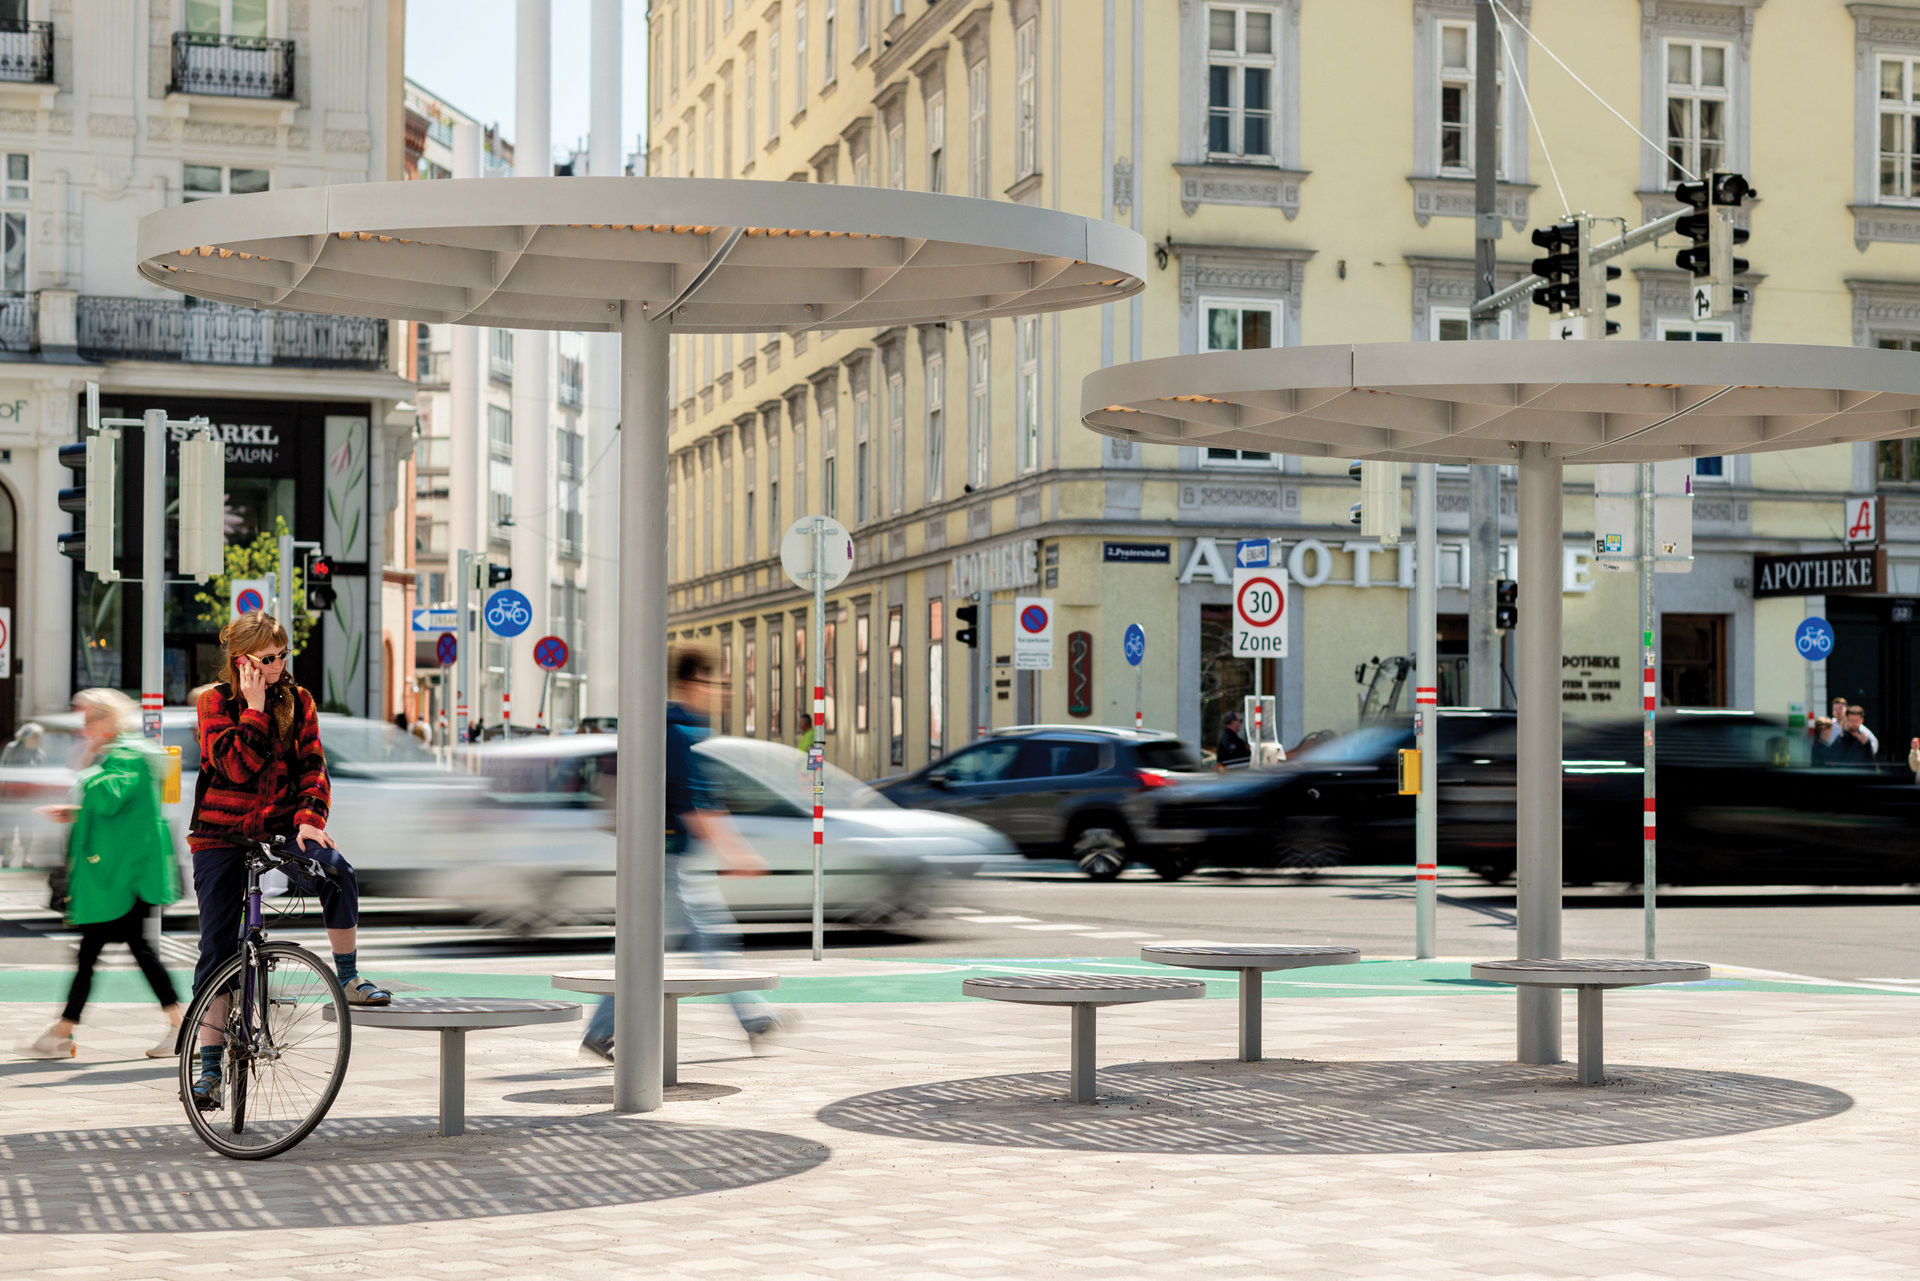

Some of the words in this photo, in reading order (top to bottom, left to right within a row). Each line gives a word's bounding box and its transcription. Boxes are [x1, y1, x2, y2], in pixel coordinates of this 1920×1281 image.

[170, 423, 280, 445] SARKL
[1849, 500, 1872, 539] A
[1179, 537, 1597, 595] AOTHE
[1759, 557, 1873, 591] APOTHEKE
[1249, 591, 1272, 614] 30
[1239, 631, 1282, 652] Zone
[1562, 655, 1621, 669] POTHEKE
